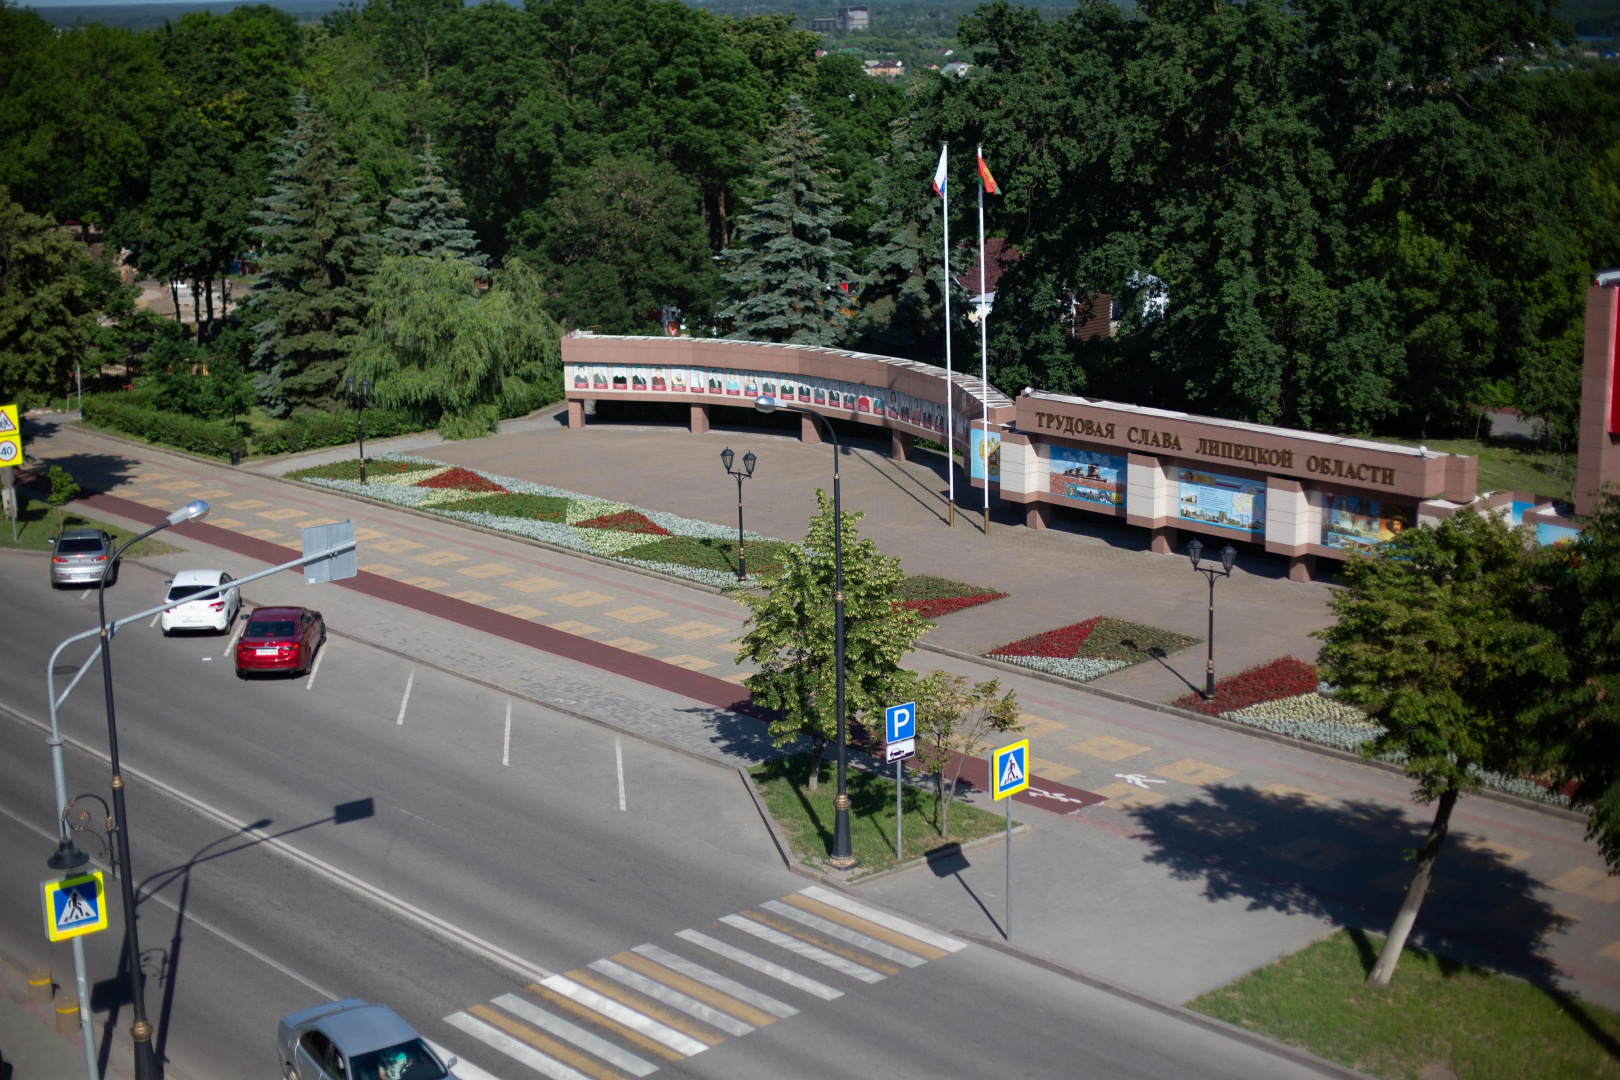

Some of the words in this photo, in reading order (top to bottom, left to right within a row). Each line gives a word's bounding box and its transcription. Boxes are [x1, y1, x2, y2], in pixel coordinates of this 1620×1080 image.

[0, 446, 13, 455] 40
[1035, 412, 1116, 439] ТРУДОВАЯ
[1127, 426, 1182, 450] СЛАВА
[1195, 438, 1294, 468] ЛИПЕЦКОЙ
[1306, 455, 1397, 485] ОБЛАСТИ
[894, 708, 910, 738] P
